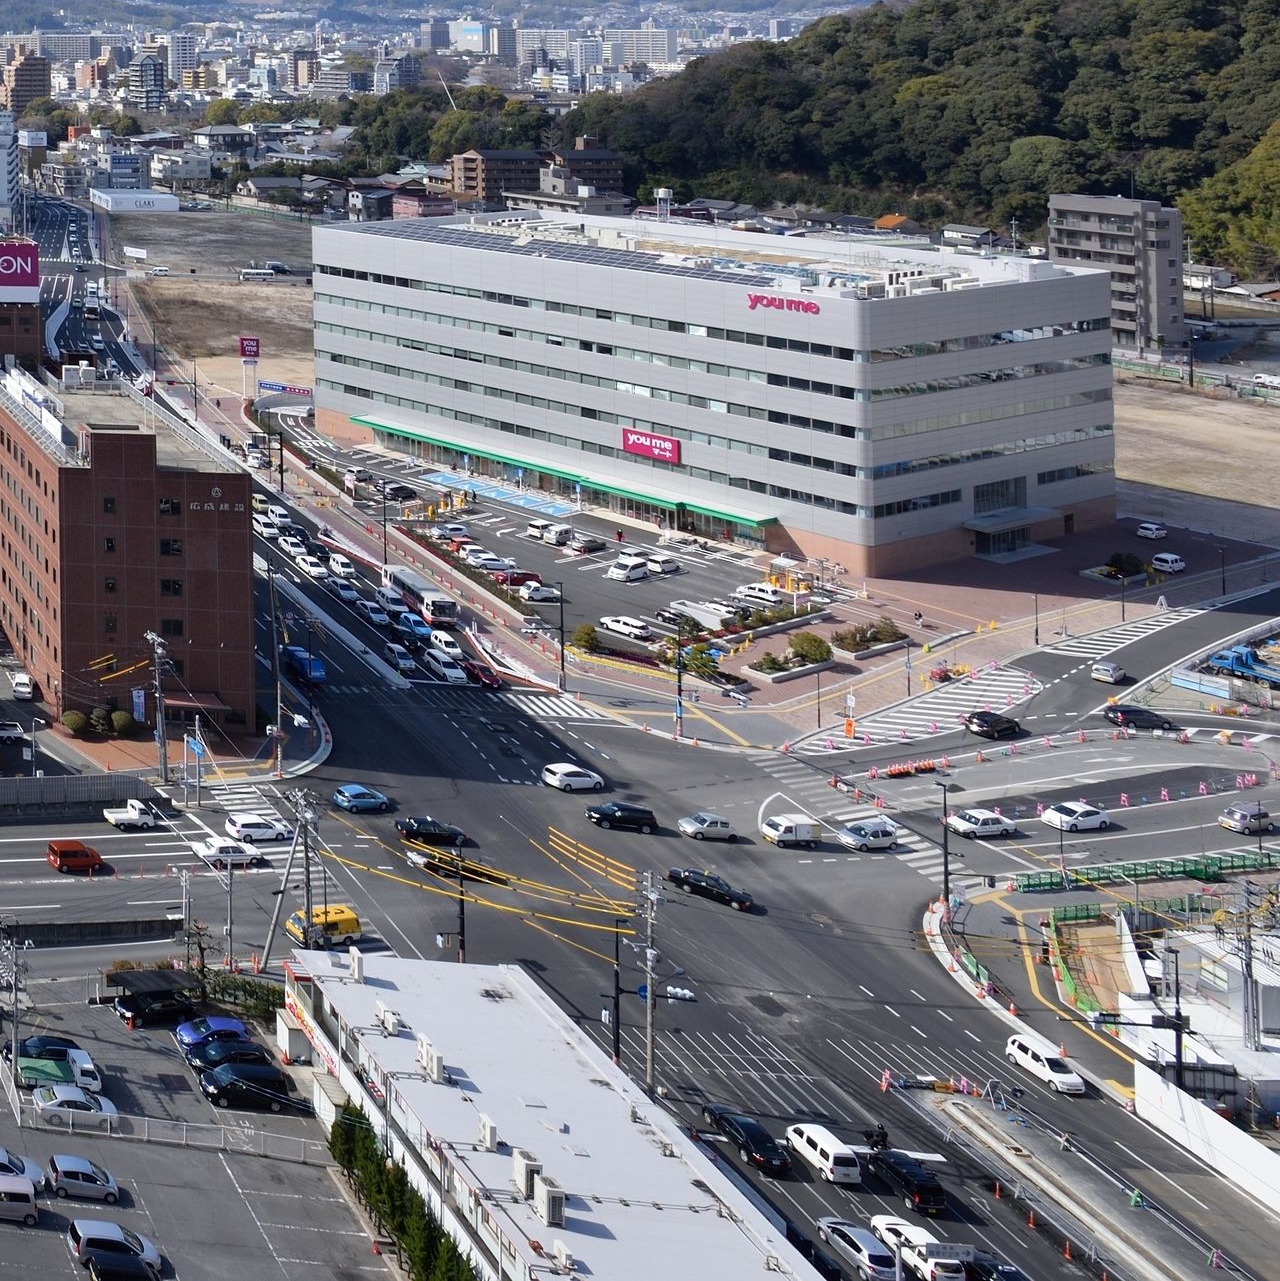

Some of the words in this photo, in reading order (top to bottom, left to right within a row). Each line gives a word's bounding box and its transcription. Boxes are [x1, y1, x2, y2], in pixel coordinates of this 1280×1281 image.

[748, 293, 785, 311] you
[786, 299, 820, 315] me
[627, 432, 651, 446] you
[651, 438, 673, 451] me
[652, 447, 673, 458] マート
